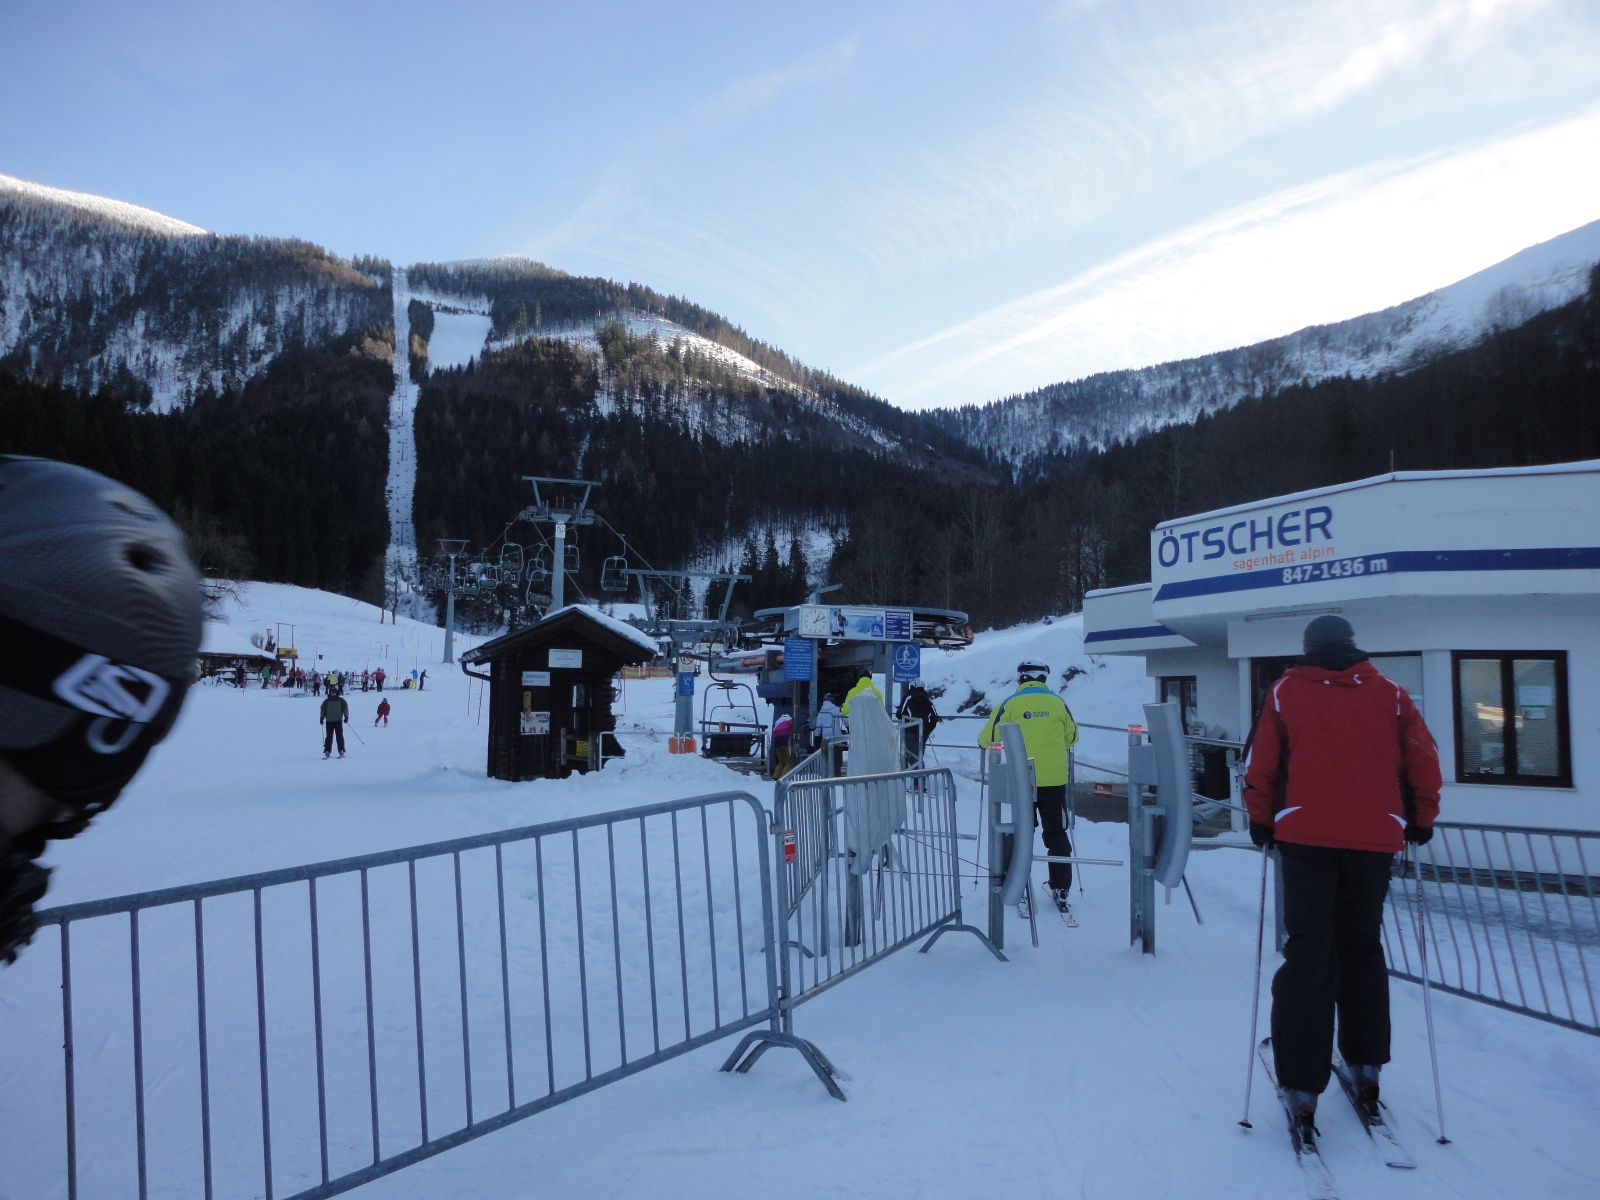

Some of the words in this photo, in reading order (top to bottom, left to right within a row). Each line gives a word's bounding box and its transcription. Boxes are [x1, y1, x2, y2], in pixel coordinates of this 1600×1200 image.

[1158, 505, 1333, 568] ÖTSCHER
[1233, 550, 1296, 571] sagenhaft
[1300, 546, 1335, 563] alpin
[1282, 559, 1365, 584] 847-1436
[1370, 558, 1388, 572] m
